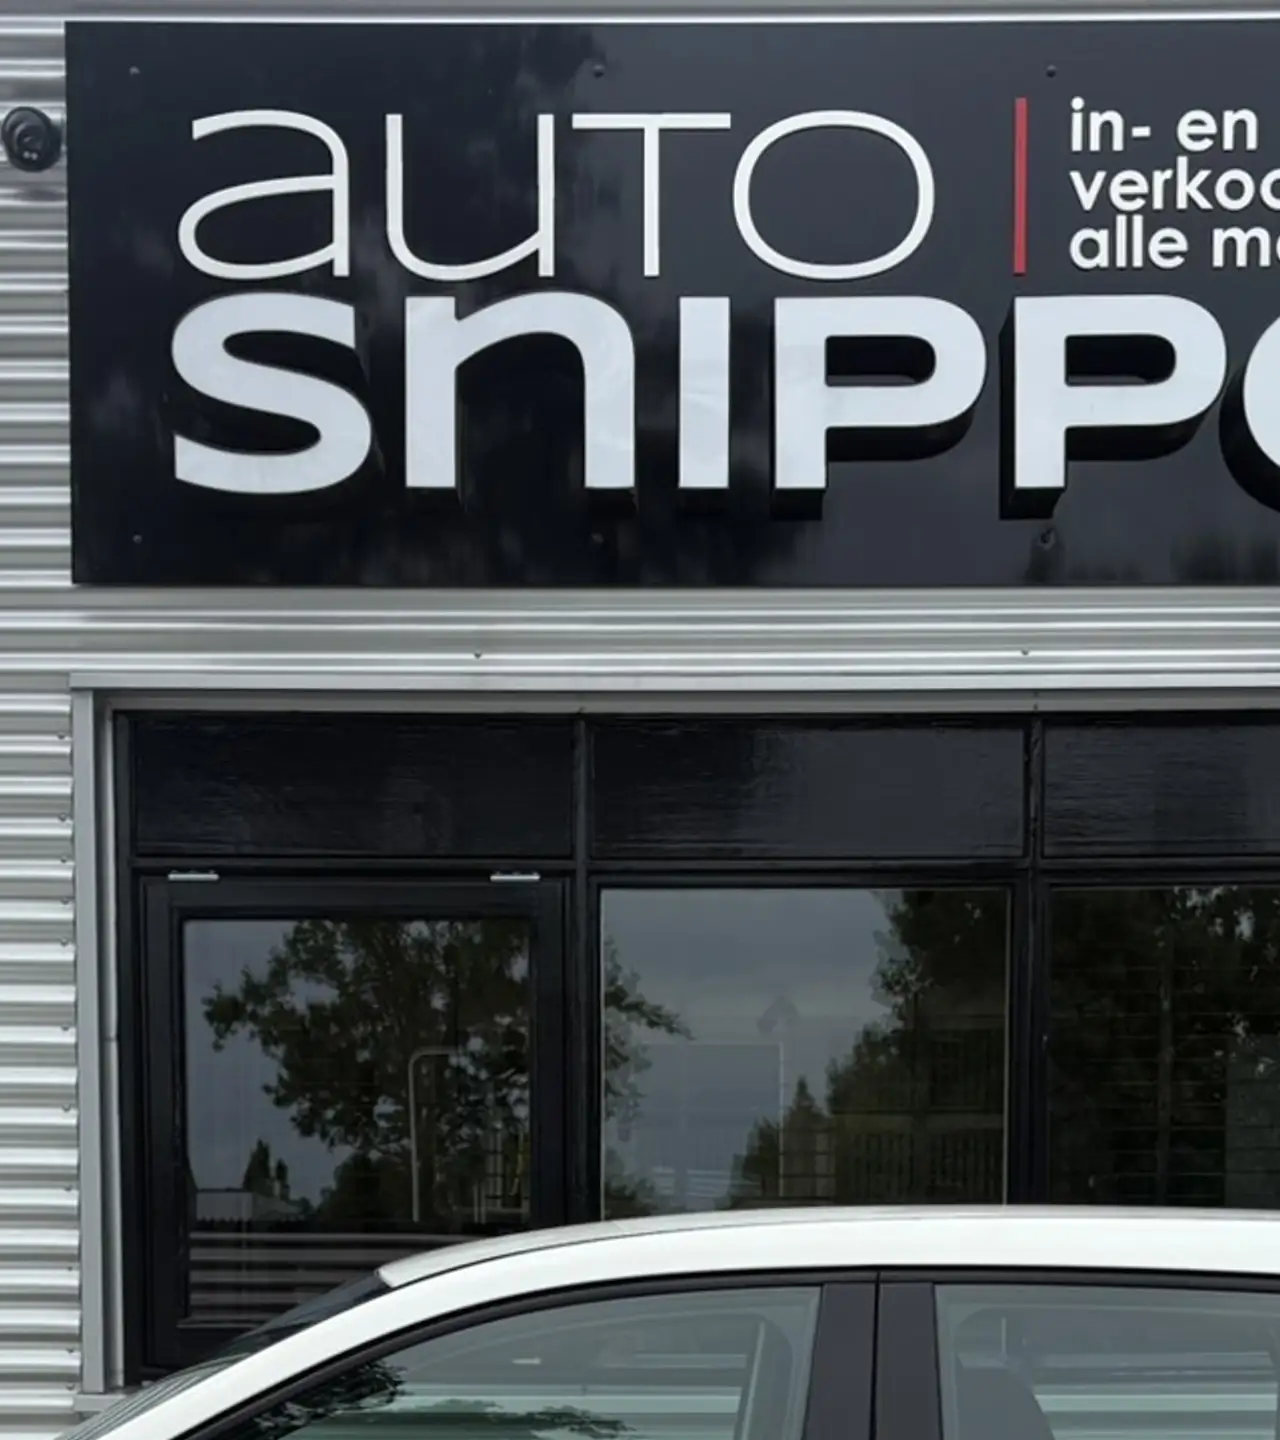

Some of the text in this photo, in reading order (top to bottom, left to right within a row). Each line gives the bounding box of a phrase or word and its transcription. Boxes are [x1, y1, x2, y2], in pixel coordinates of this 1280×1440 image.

[1070, 96, 1259, 152] in- en
[1068, 212, 1189, 269] alle
